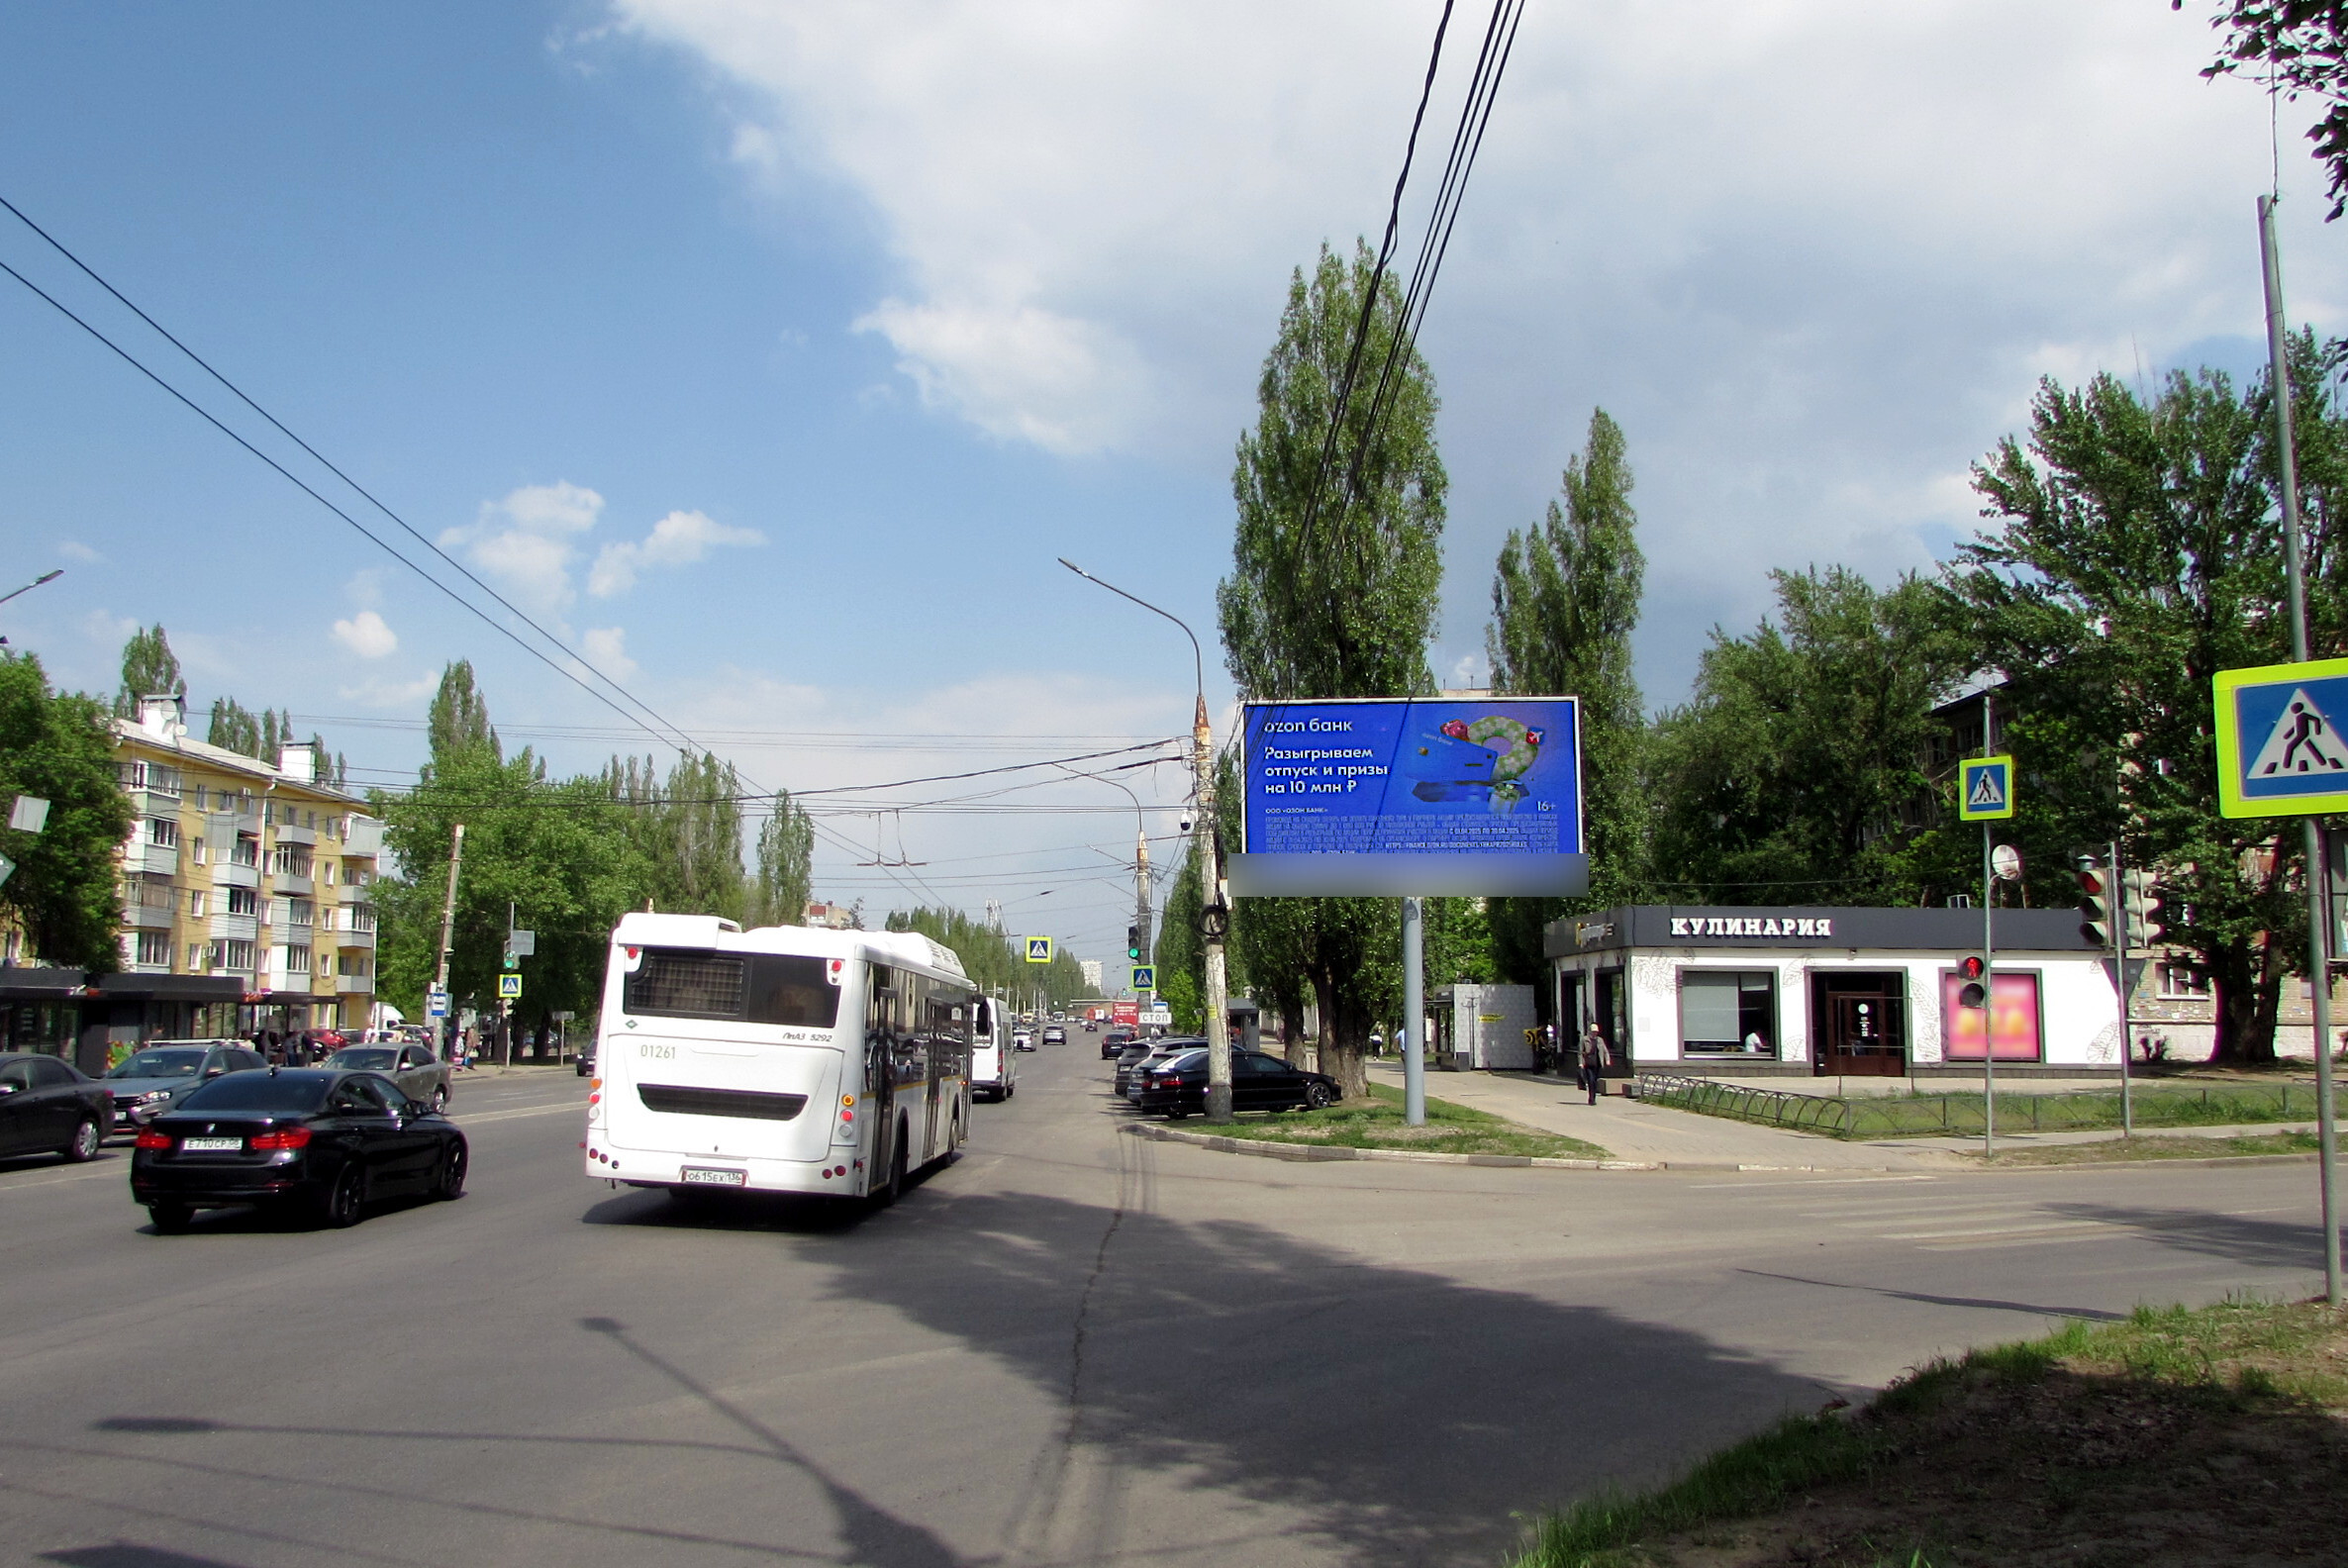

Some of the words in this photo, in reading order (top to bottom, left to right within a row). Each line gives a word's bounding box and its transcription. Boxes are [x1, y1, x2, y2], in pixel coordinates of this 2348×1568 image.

[1264, 721, 1306, 733] ozon
[1309, 718, 1353, 733] банк
[1264, 746, 1374, 762] Разыгрываем
[1264, 766, 1318, 779] отпуск
[1322, 766, 1333, 776] и
[1337, 765, 1388, 778] призы
[1265, 784, 1285, 794] на
[1290, 780, 1306, 794] 10
[1310, 783, 1342, 793] млн
[1537, 800, 1556, 812] 16+
[1670, 917, 1832, 937] КУЛИНАРИЯ
[810, 1033, 833, 1042] 5292
[640, 1044, 676, 1059] 01261
